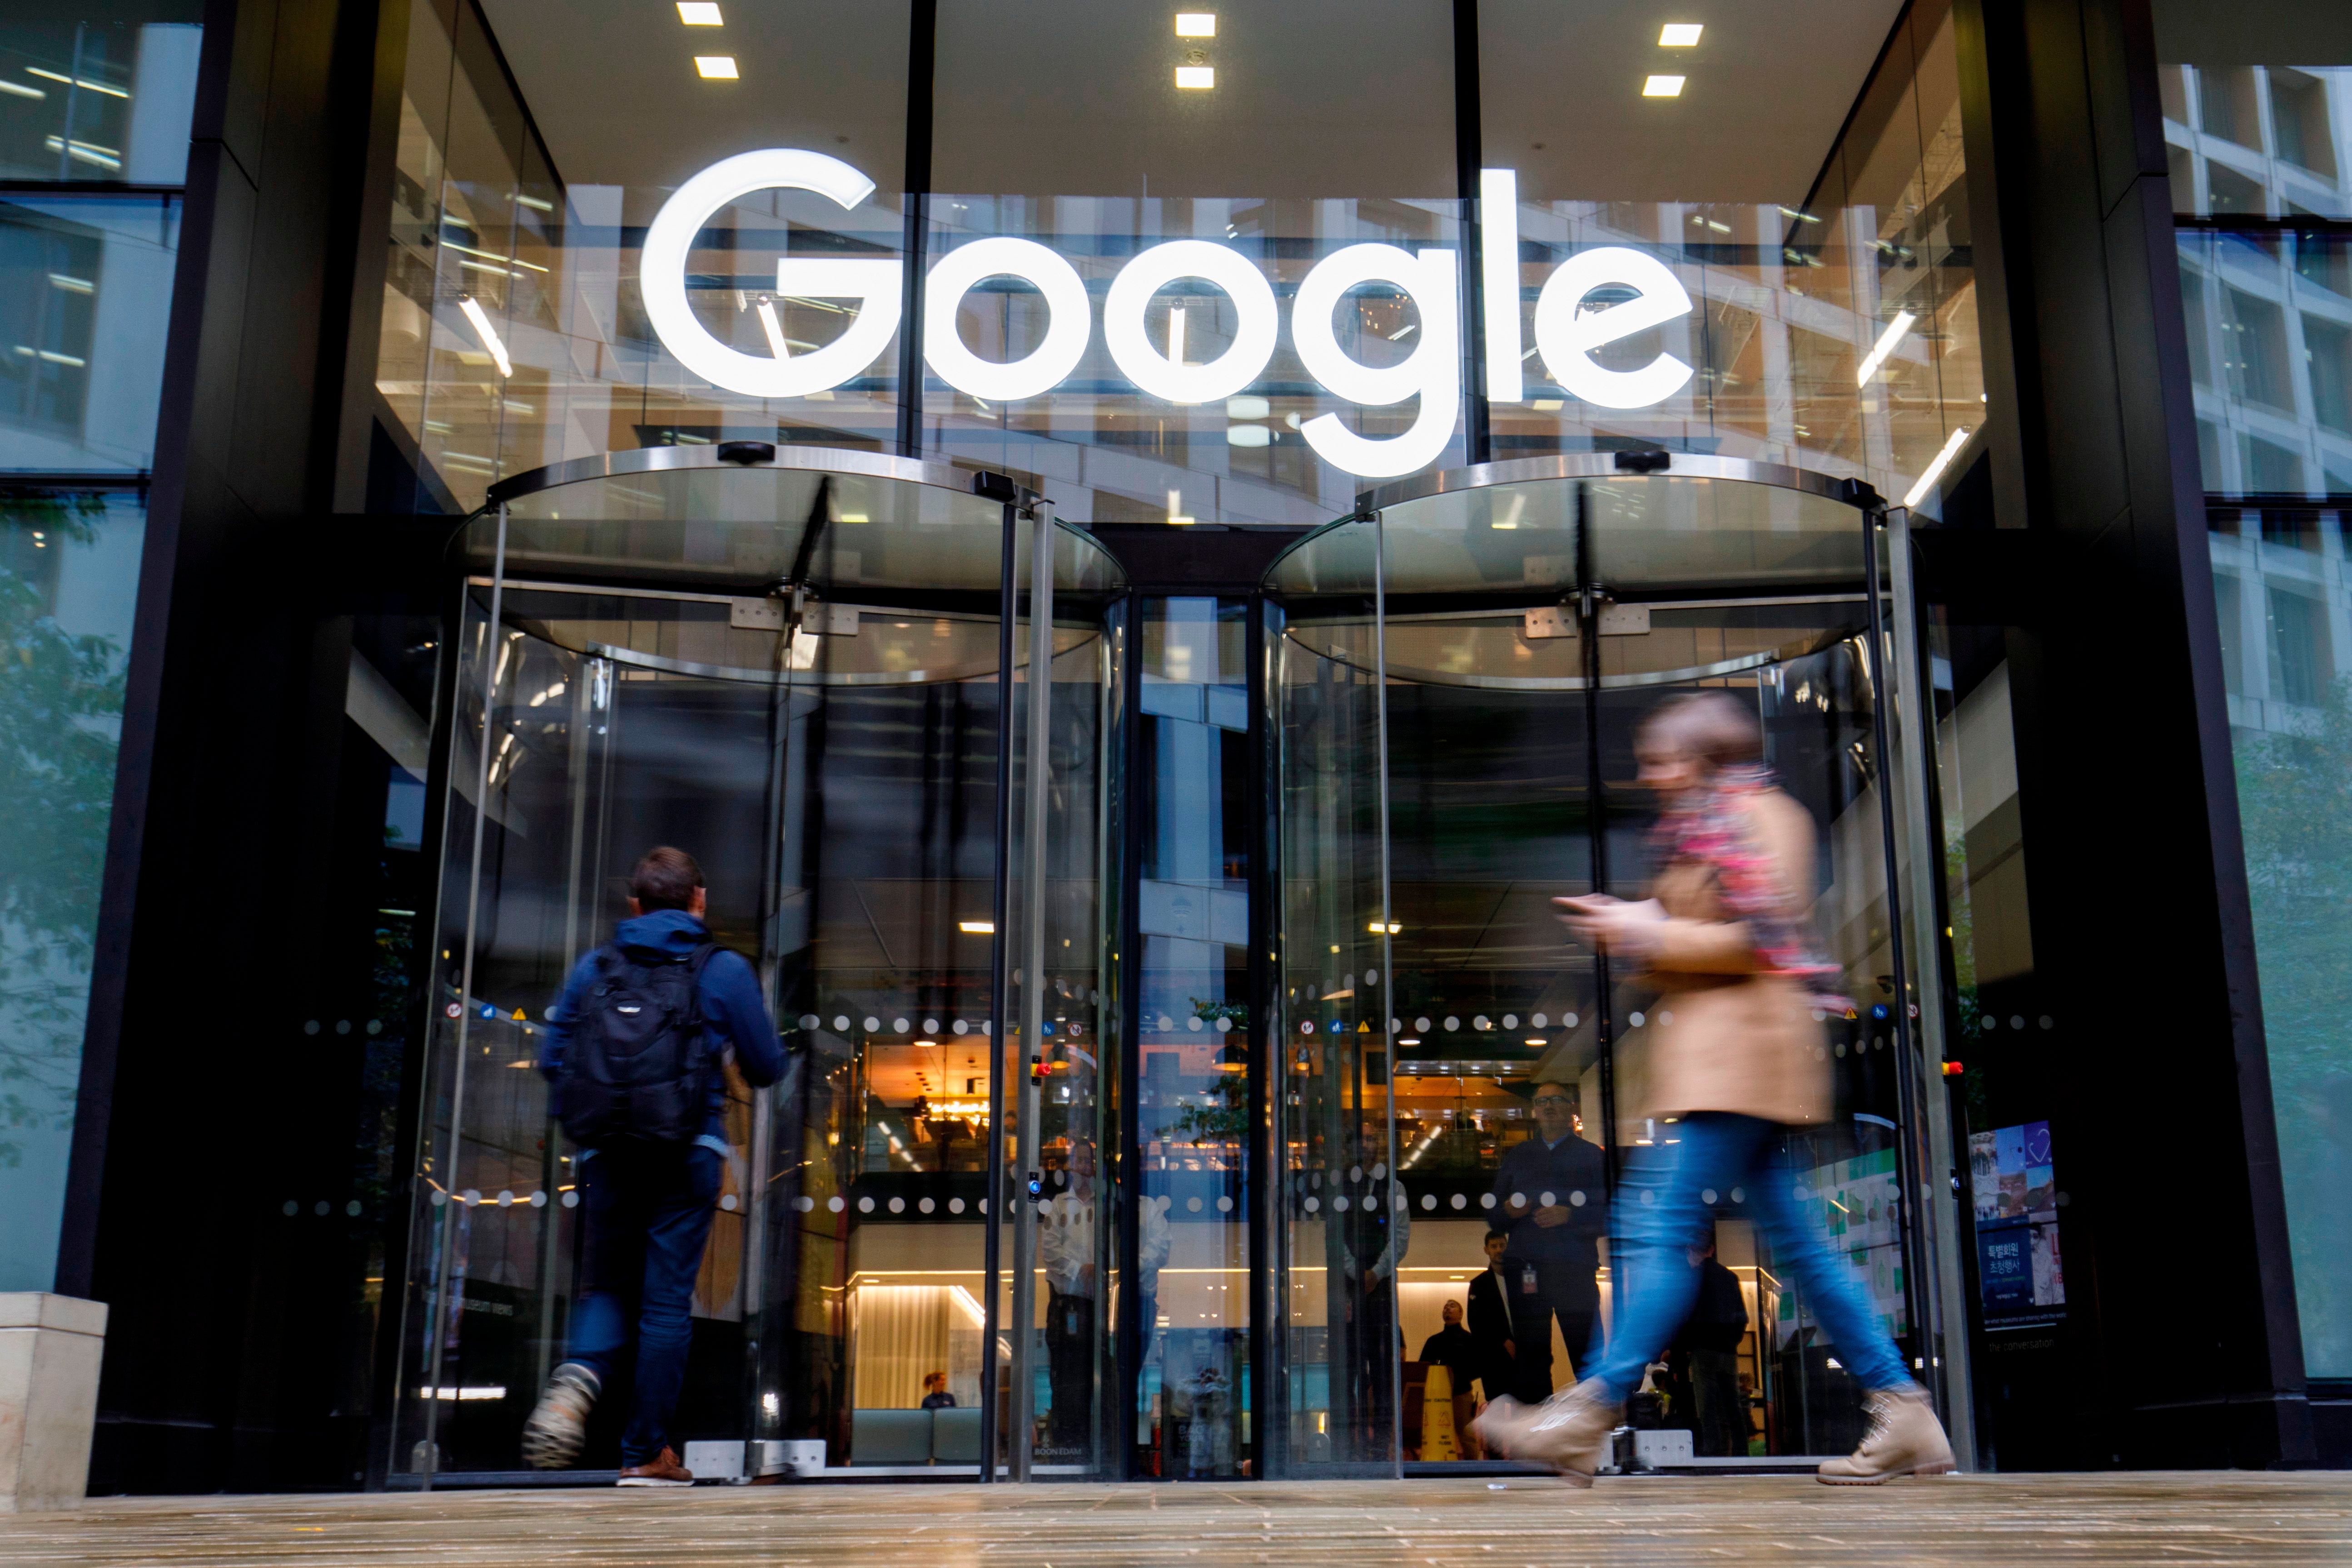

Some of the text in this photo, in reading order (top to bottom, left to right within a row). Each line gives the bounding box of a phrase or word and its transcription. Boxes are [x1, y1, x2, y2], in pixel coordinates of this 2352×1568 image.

[641, 149, 1694, 478] Google
[1988, 1242, 2019, 1259] 특별회원
[1990, 1258, 2020, 1274] 초청행사
[1989, 1339, 2055, 1352] the conversation
